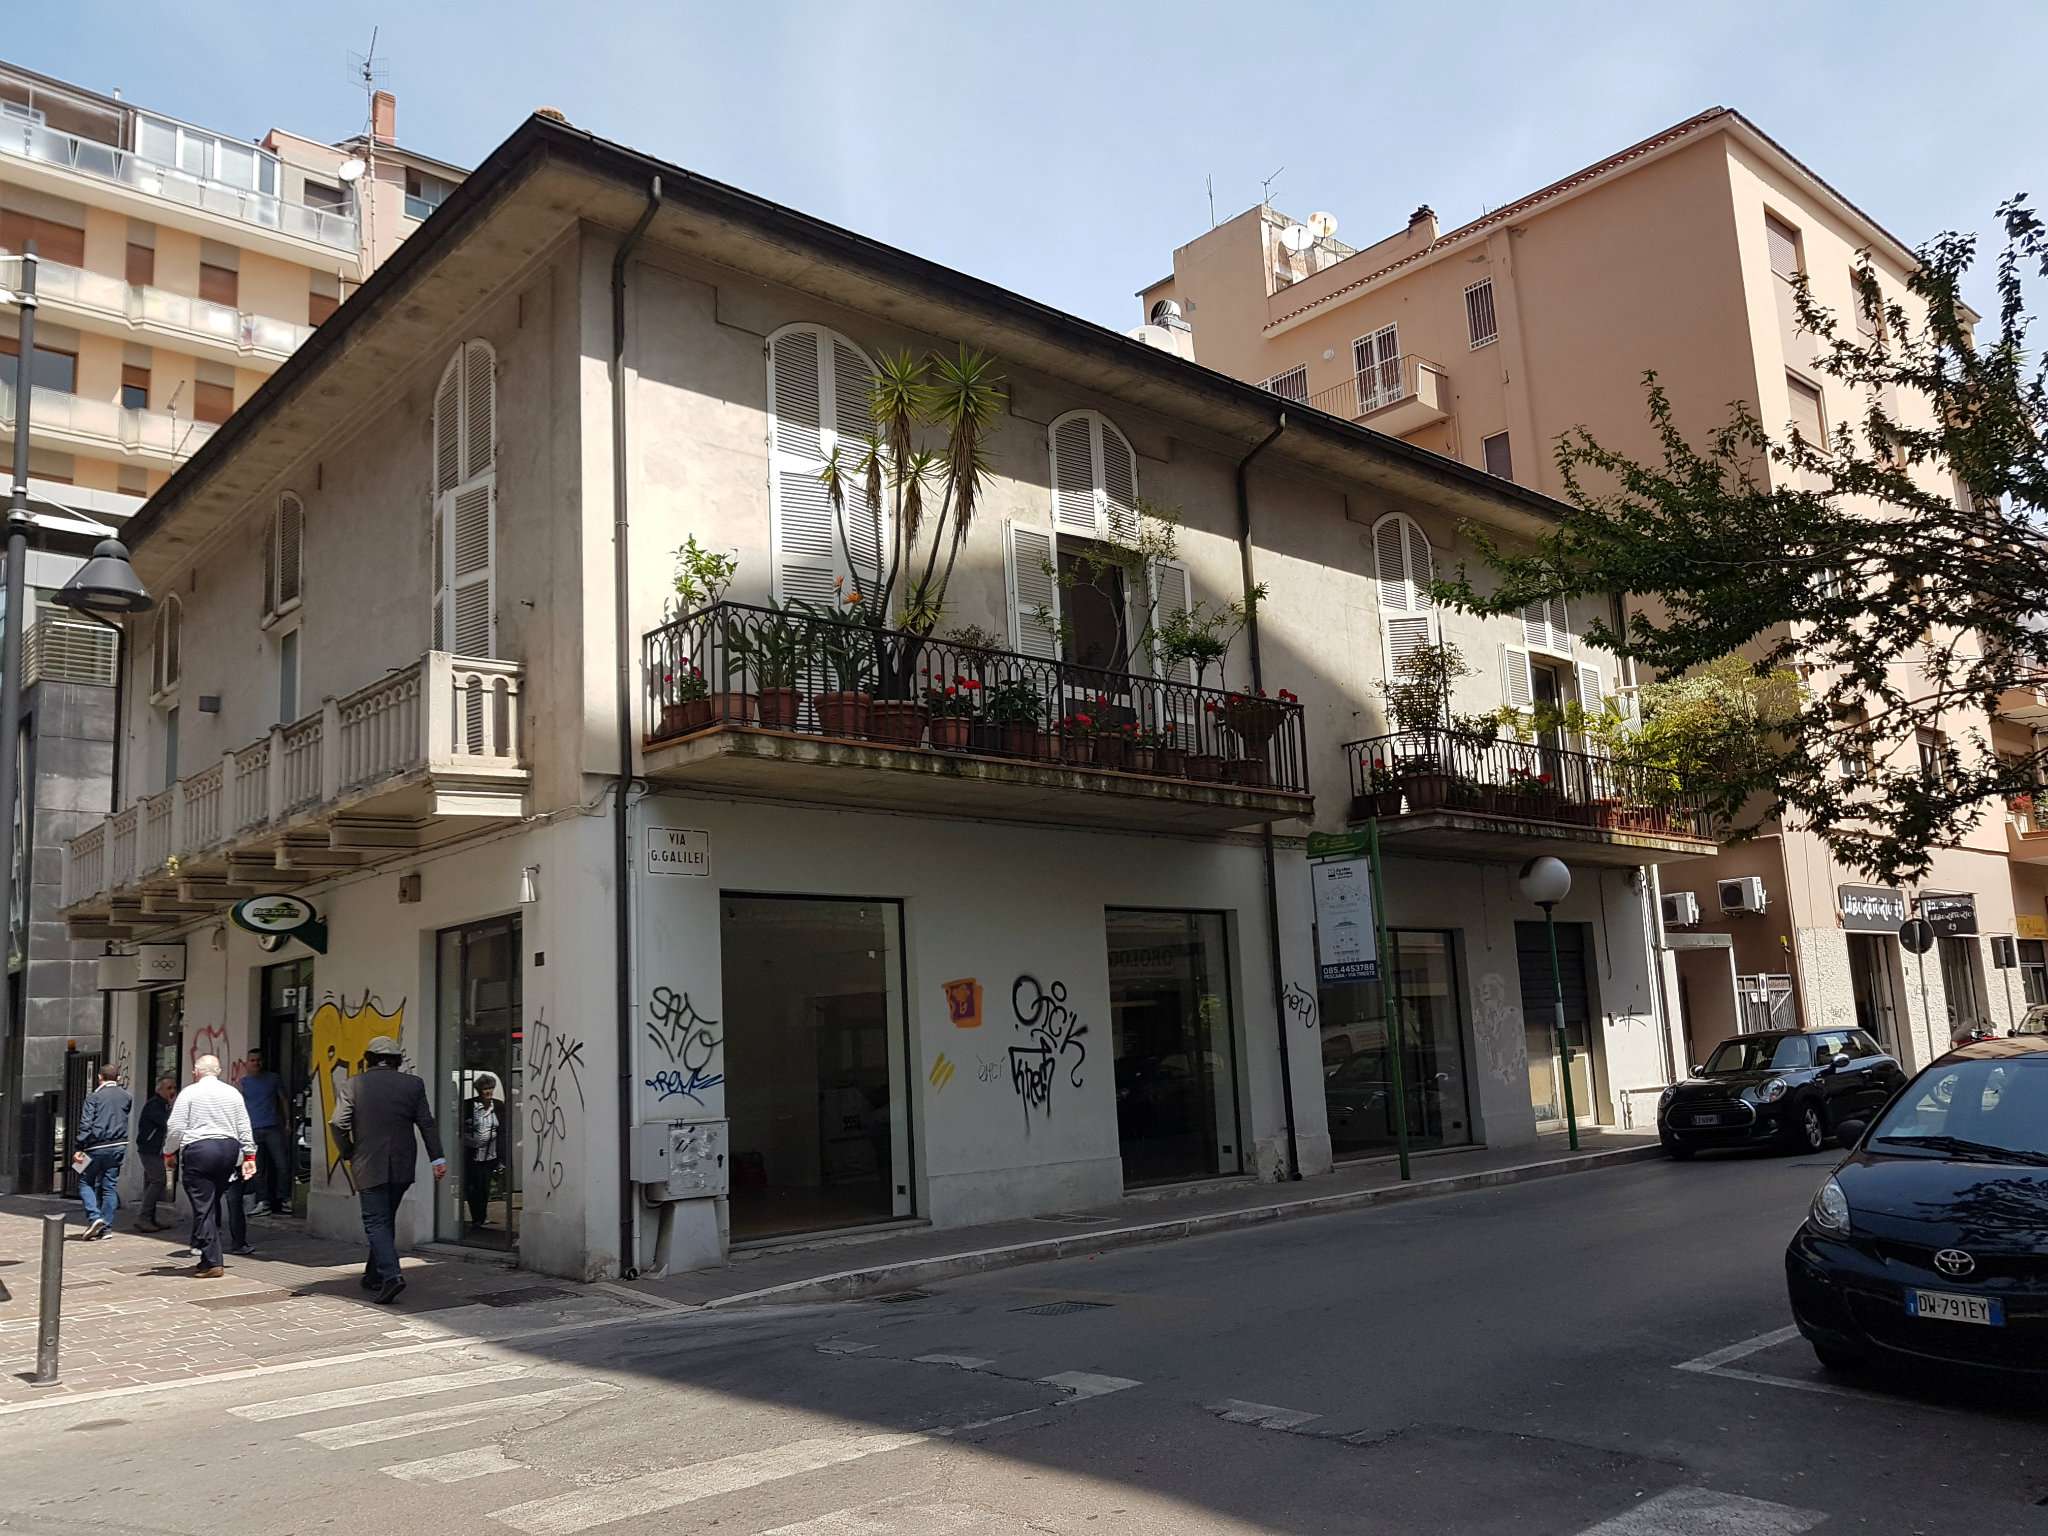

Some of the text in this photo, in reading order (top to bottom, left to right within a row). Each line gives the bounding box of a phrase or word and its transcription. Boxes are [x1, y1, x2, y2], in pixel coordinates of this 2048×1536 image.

[669, 833, 686, 846] VIA
[651, 850, 704, 864] G.GALILEI
[1941, 1298, 1987, 1321] 791EY
